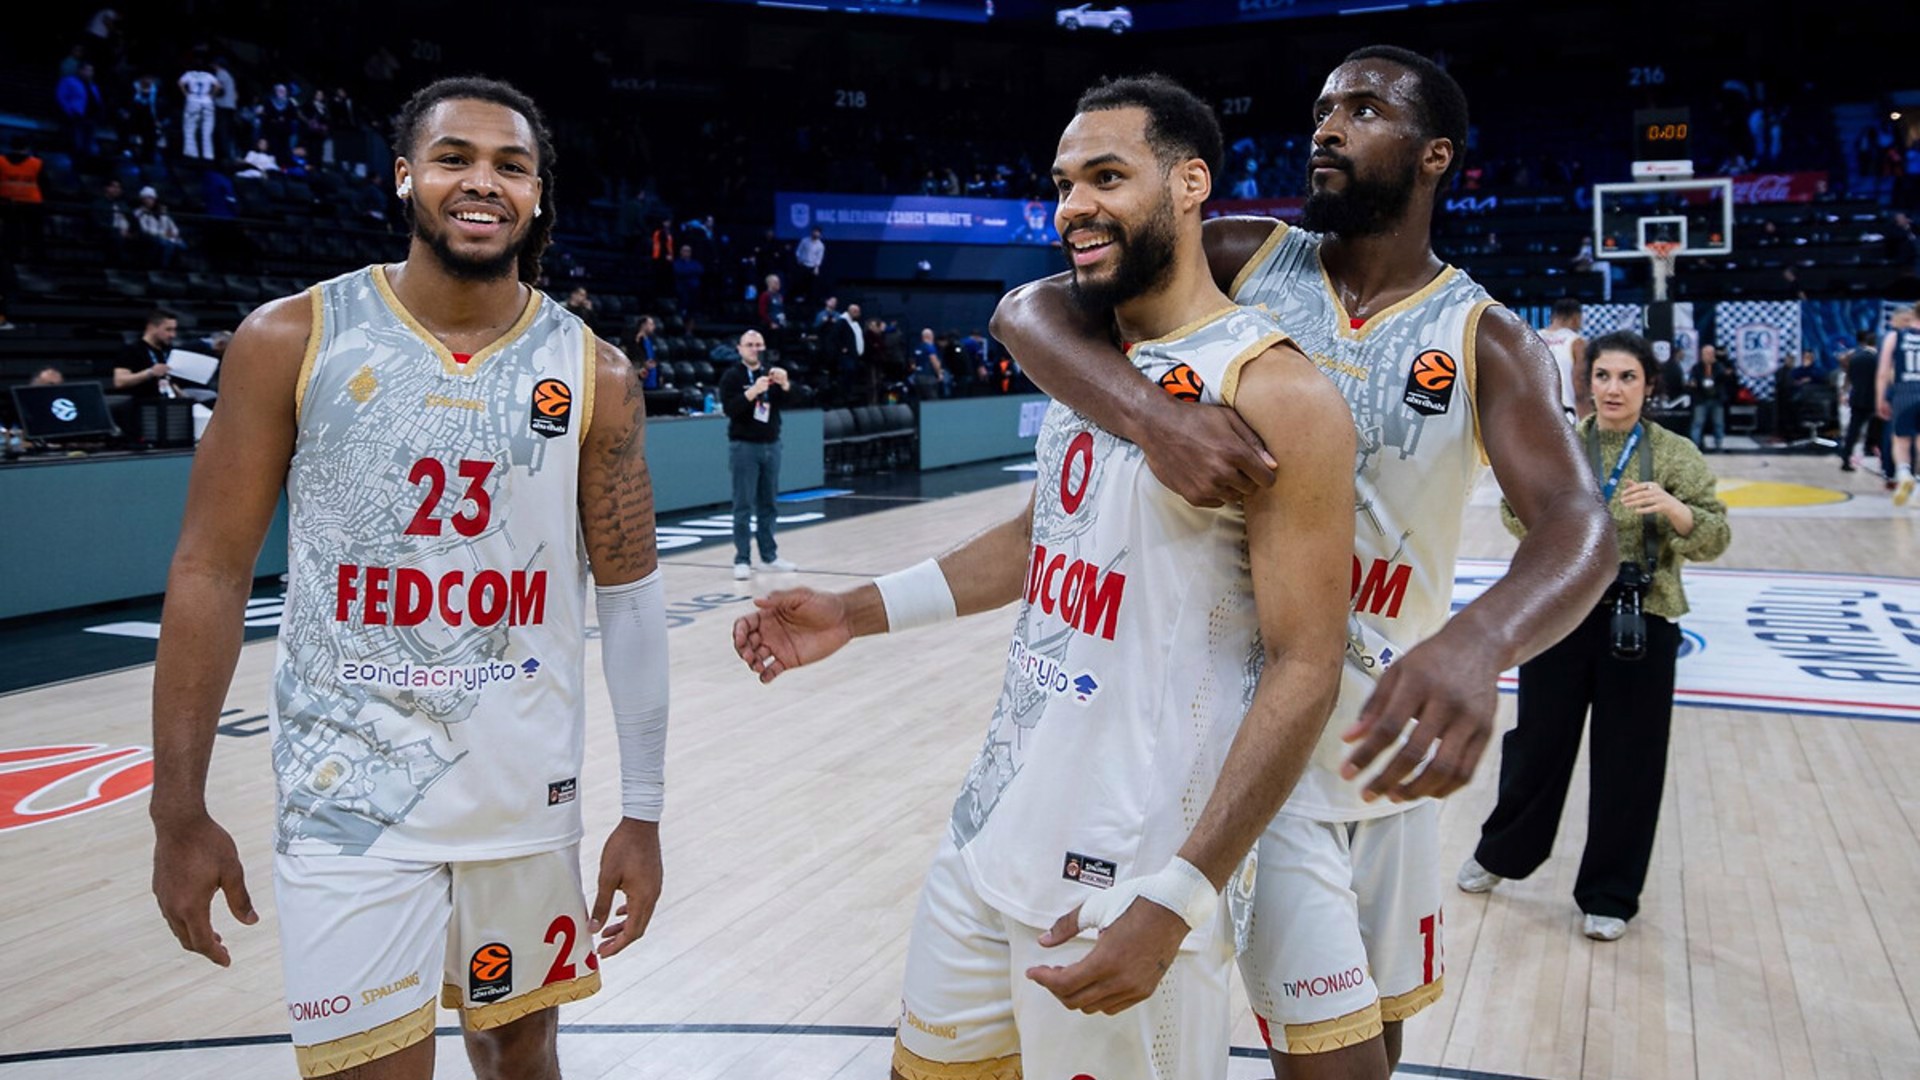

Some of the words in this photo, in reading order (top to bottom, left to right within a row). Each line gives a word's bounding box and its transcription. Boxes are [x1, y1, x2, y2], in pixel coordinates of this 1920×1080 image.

[834, 89, 867, 109] 218
[1627, 65, 1665, 88] 216
[1221, 97, 1252, 115] 217
[403, 456, 496, 537] 23
[1060, 431, 1094, 515] 0
[336, 563, 548, 627] FEDCOM
[1025, 544, 1126, 641] DCOM
[343, 661, 516, 691] zondacrypto
[542, 915, 599, 987] 2
[289, 995, 351, 1022] ONACO
[361, 971, 420, 1006] SPALDING
